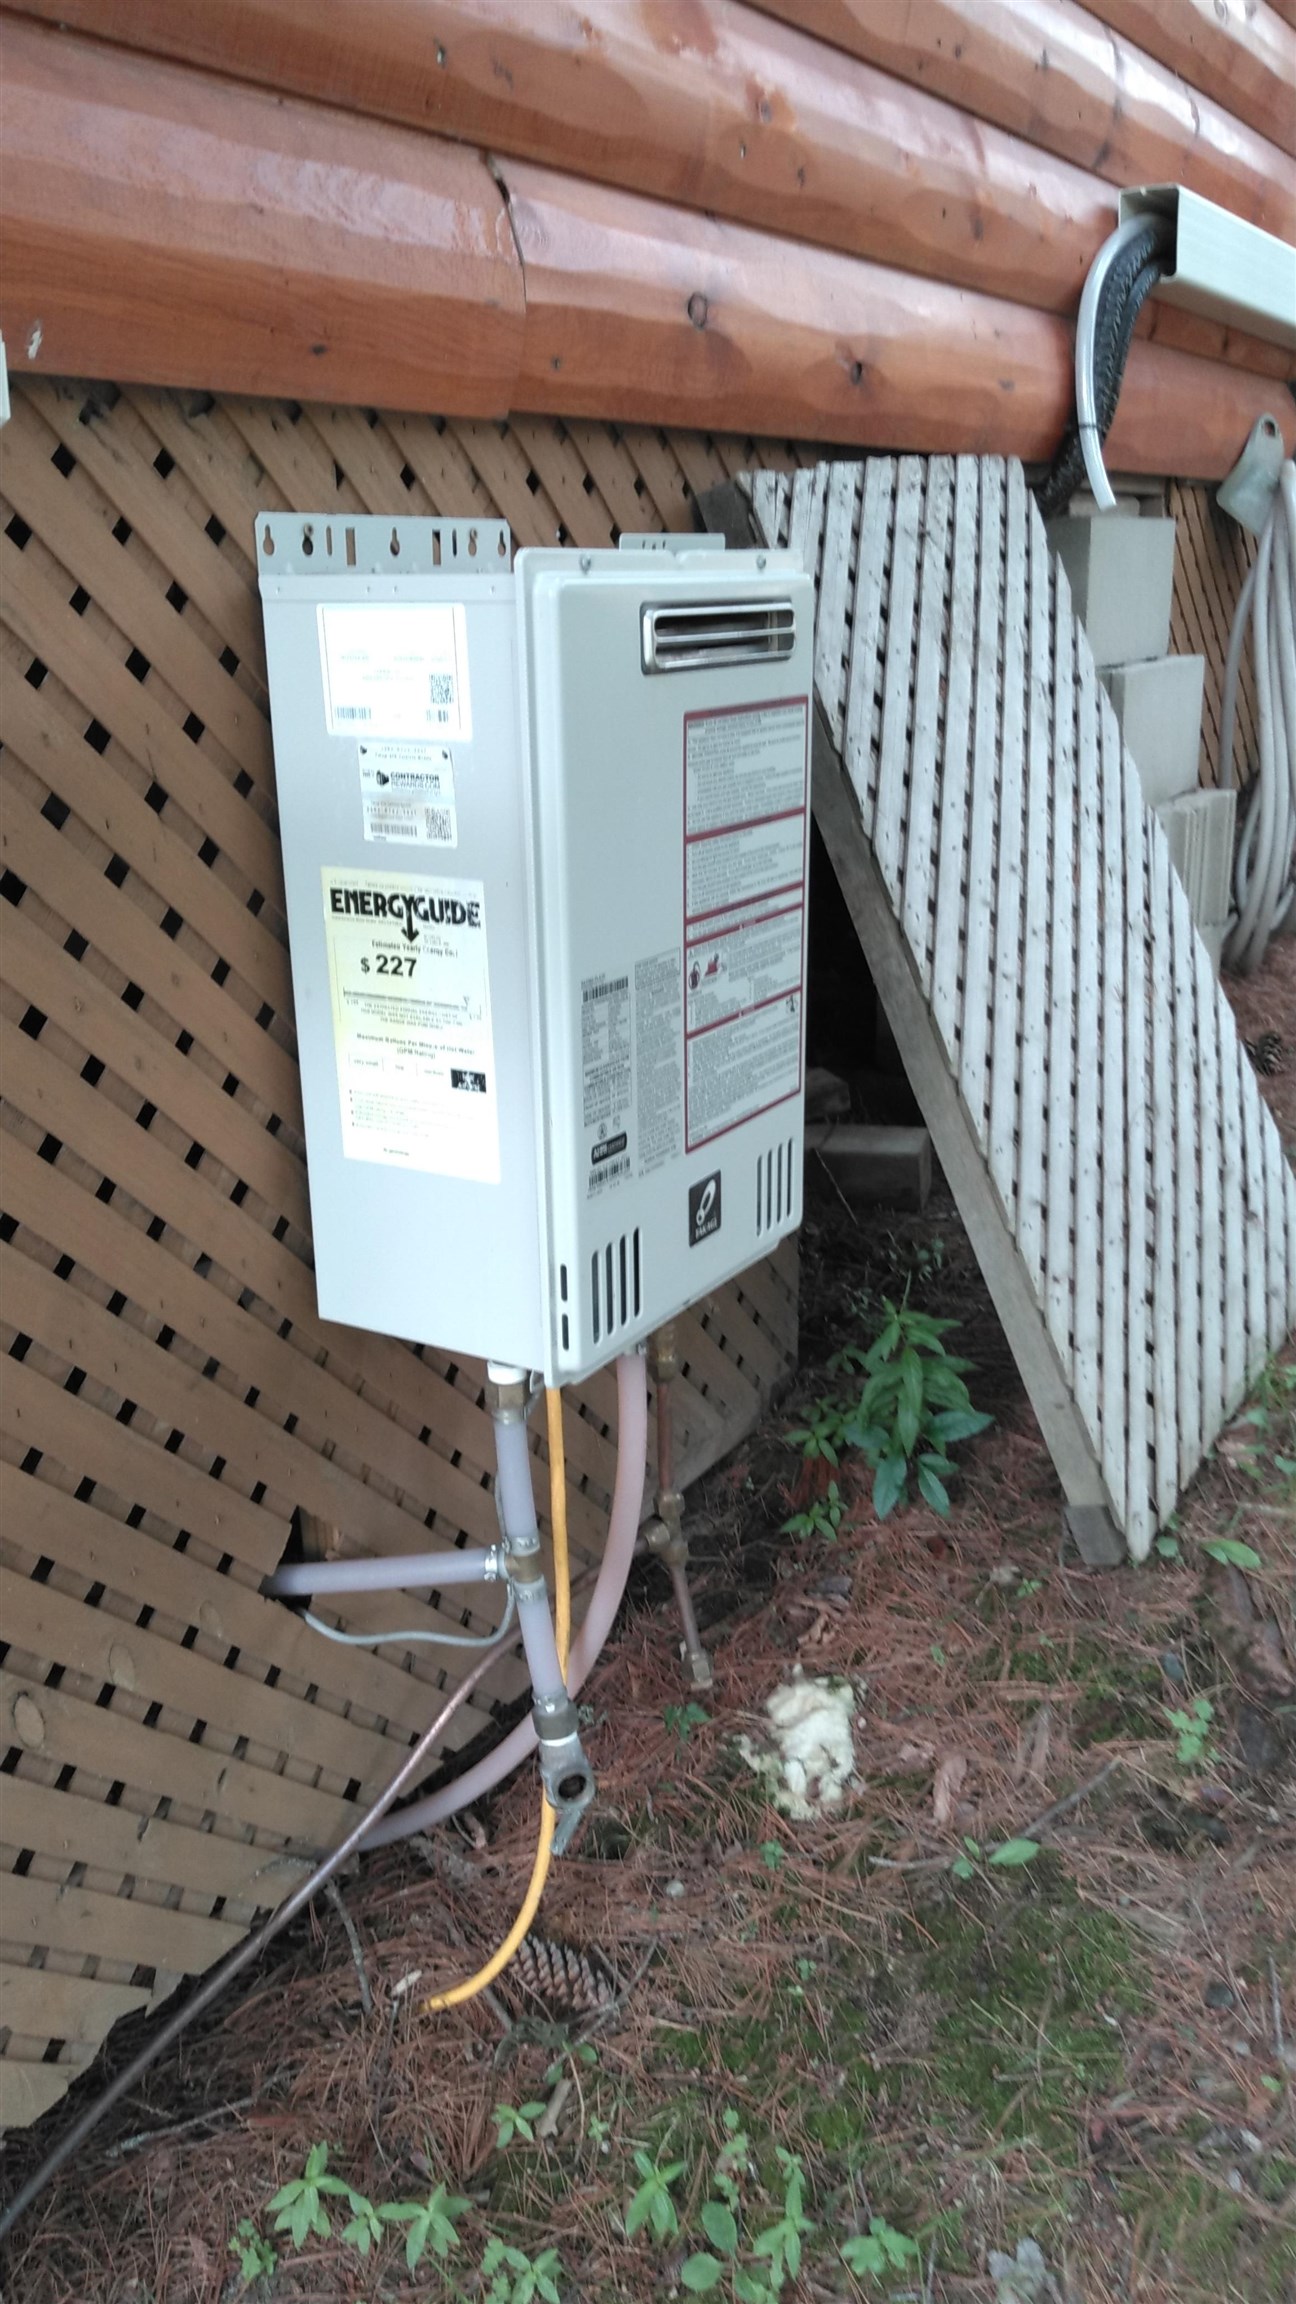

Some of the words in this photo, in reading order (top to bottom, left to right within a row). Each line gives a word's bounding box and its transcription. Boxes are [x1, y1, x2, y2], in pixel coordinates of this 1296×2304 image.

[390, 772, 439, 783] CONTRACTOR
[330, 888, 481, 929] ENERGYGUIDE
[360, 957, 370, 974] $
[375, 954, 417, 977] 227
